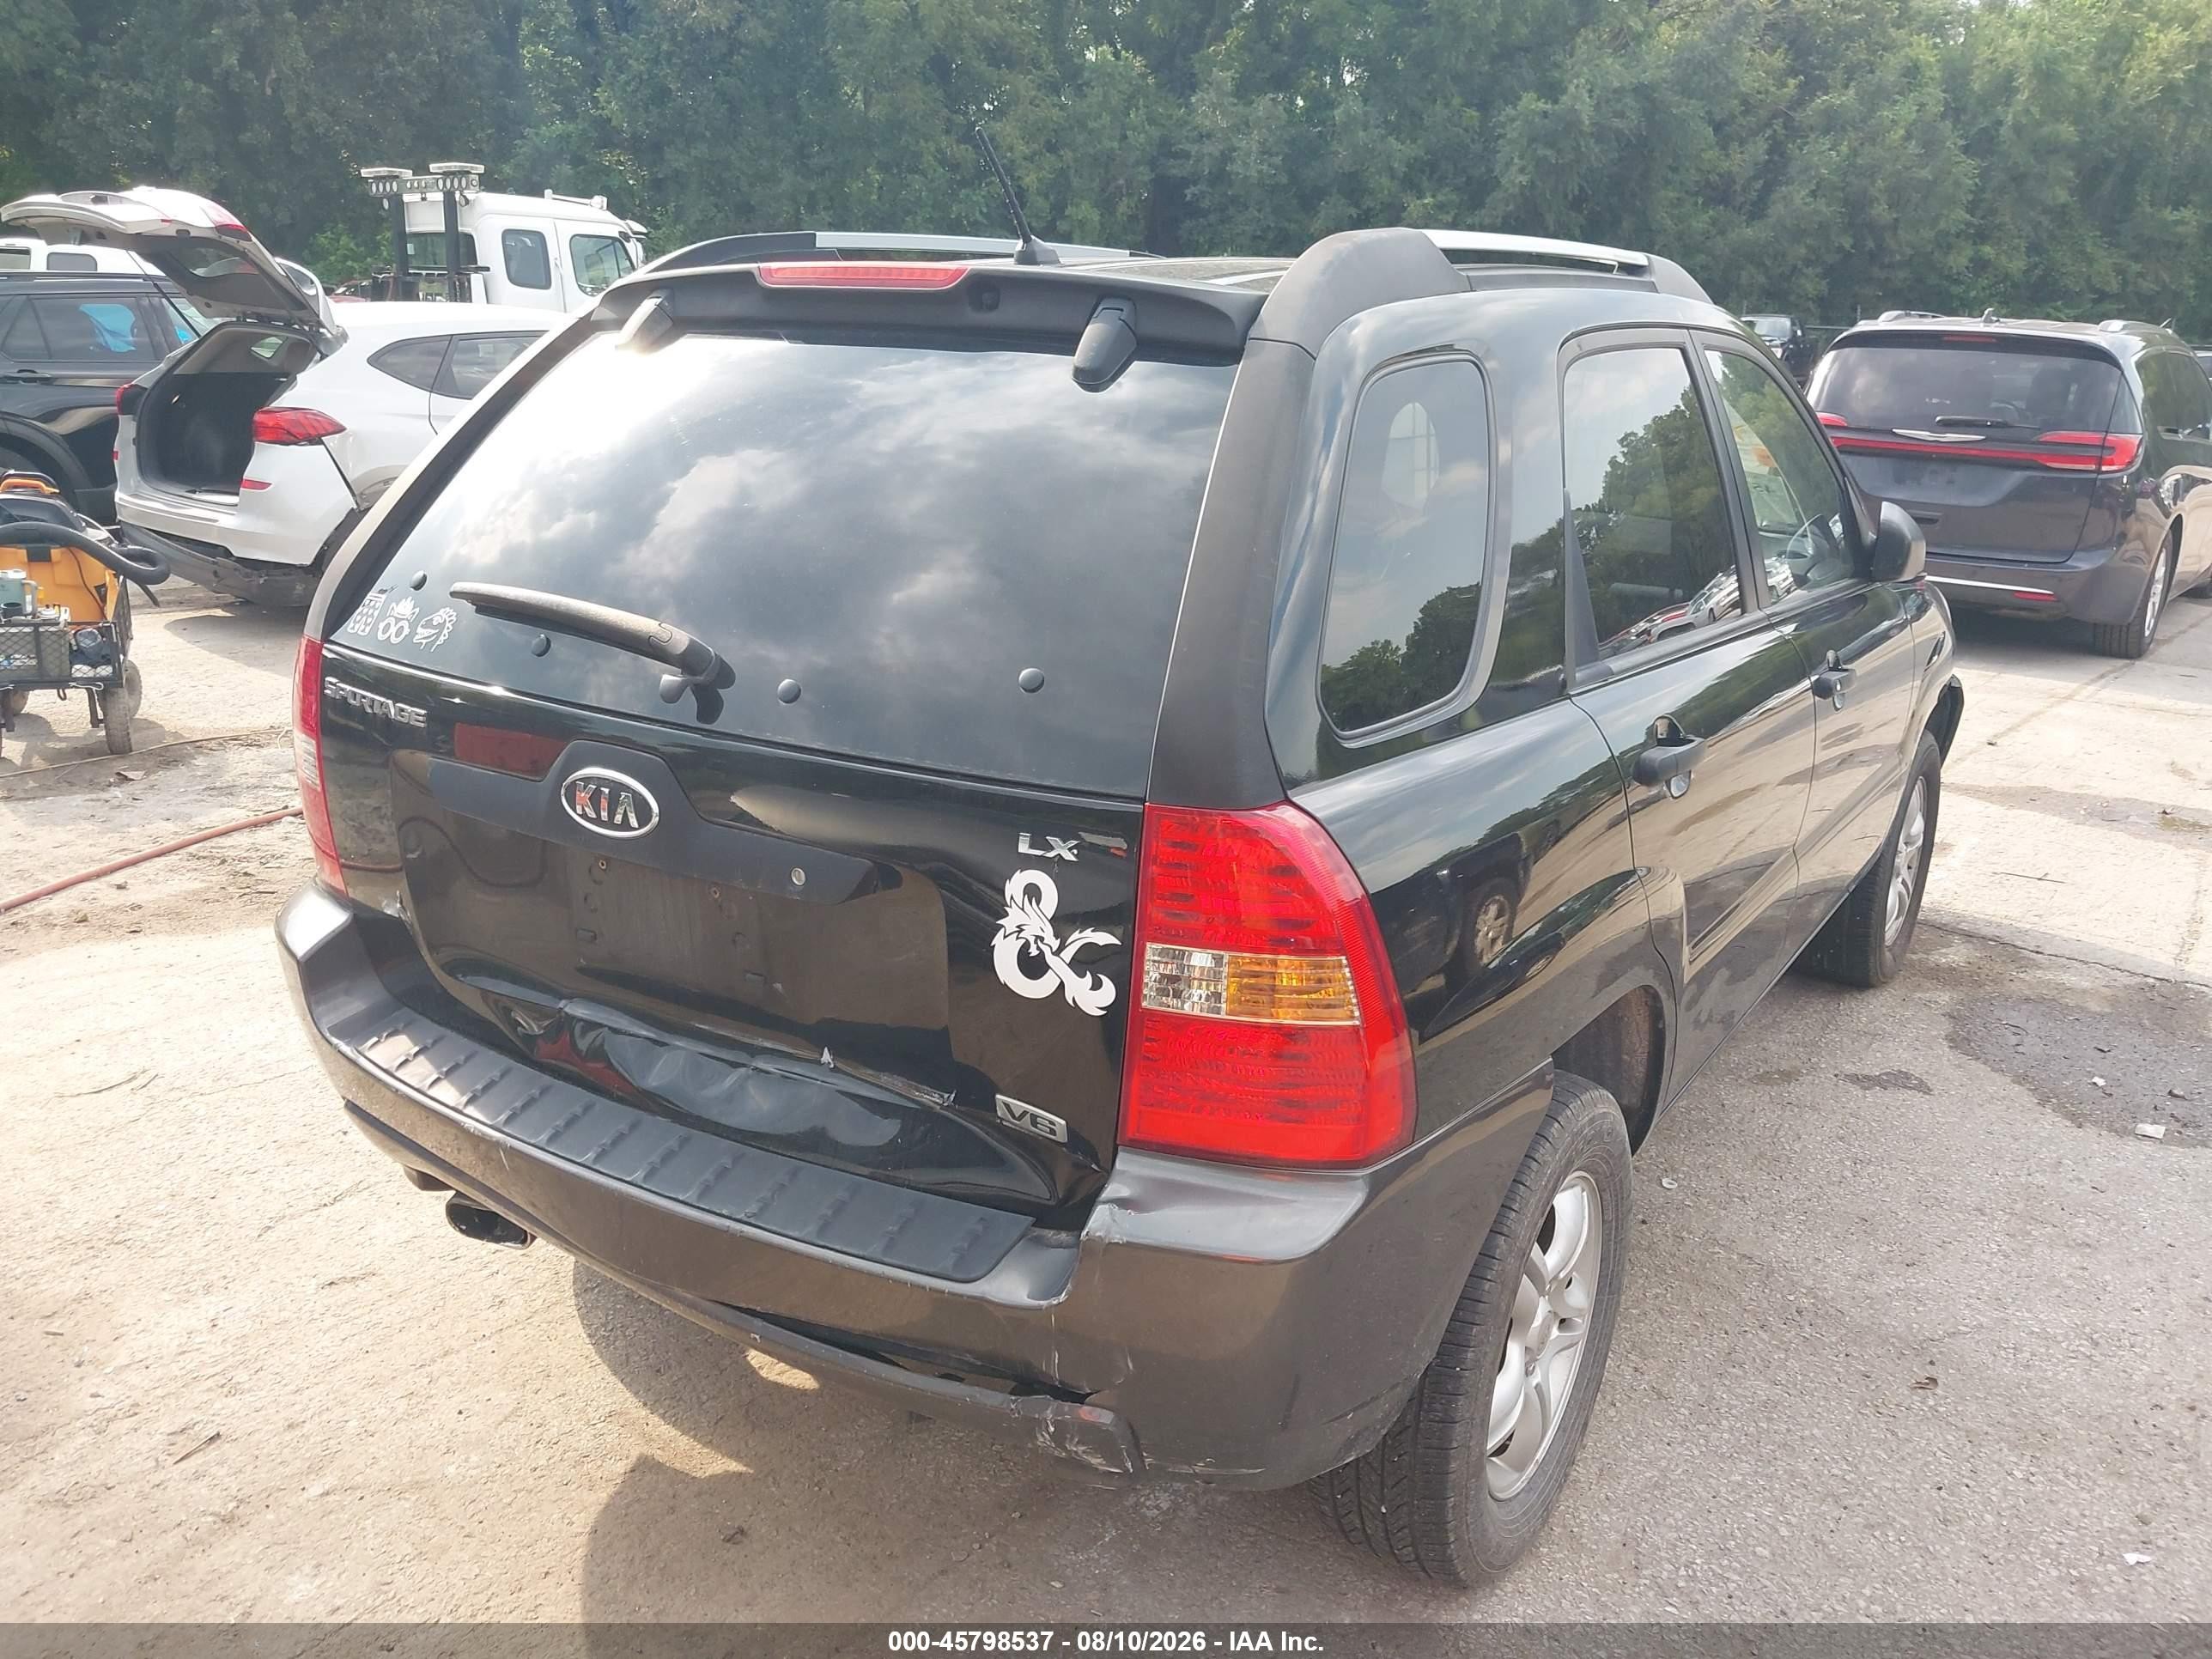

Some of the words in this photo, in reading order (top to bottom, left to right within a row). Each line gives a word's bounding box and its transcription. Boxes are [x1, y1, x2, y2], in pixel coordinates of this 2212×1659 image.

[324, 677, 428, 728] SPORTAGE
[574, 780, 641, 830] KIA
[1017, 831, 1079, 862] LX
